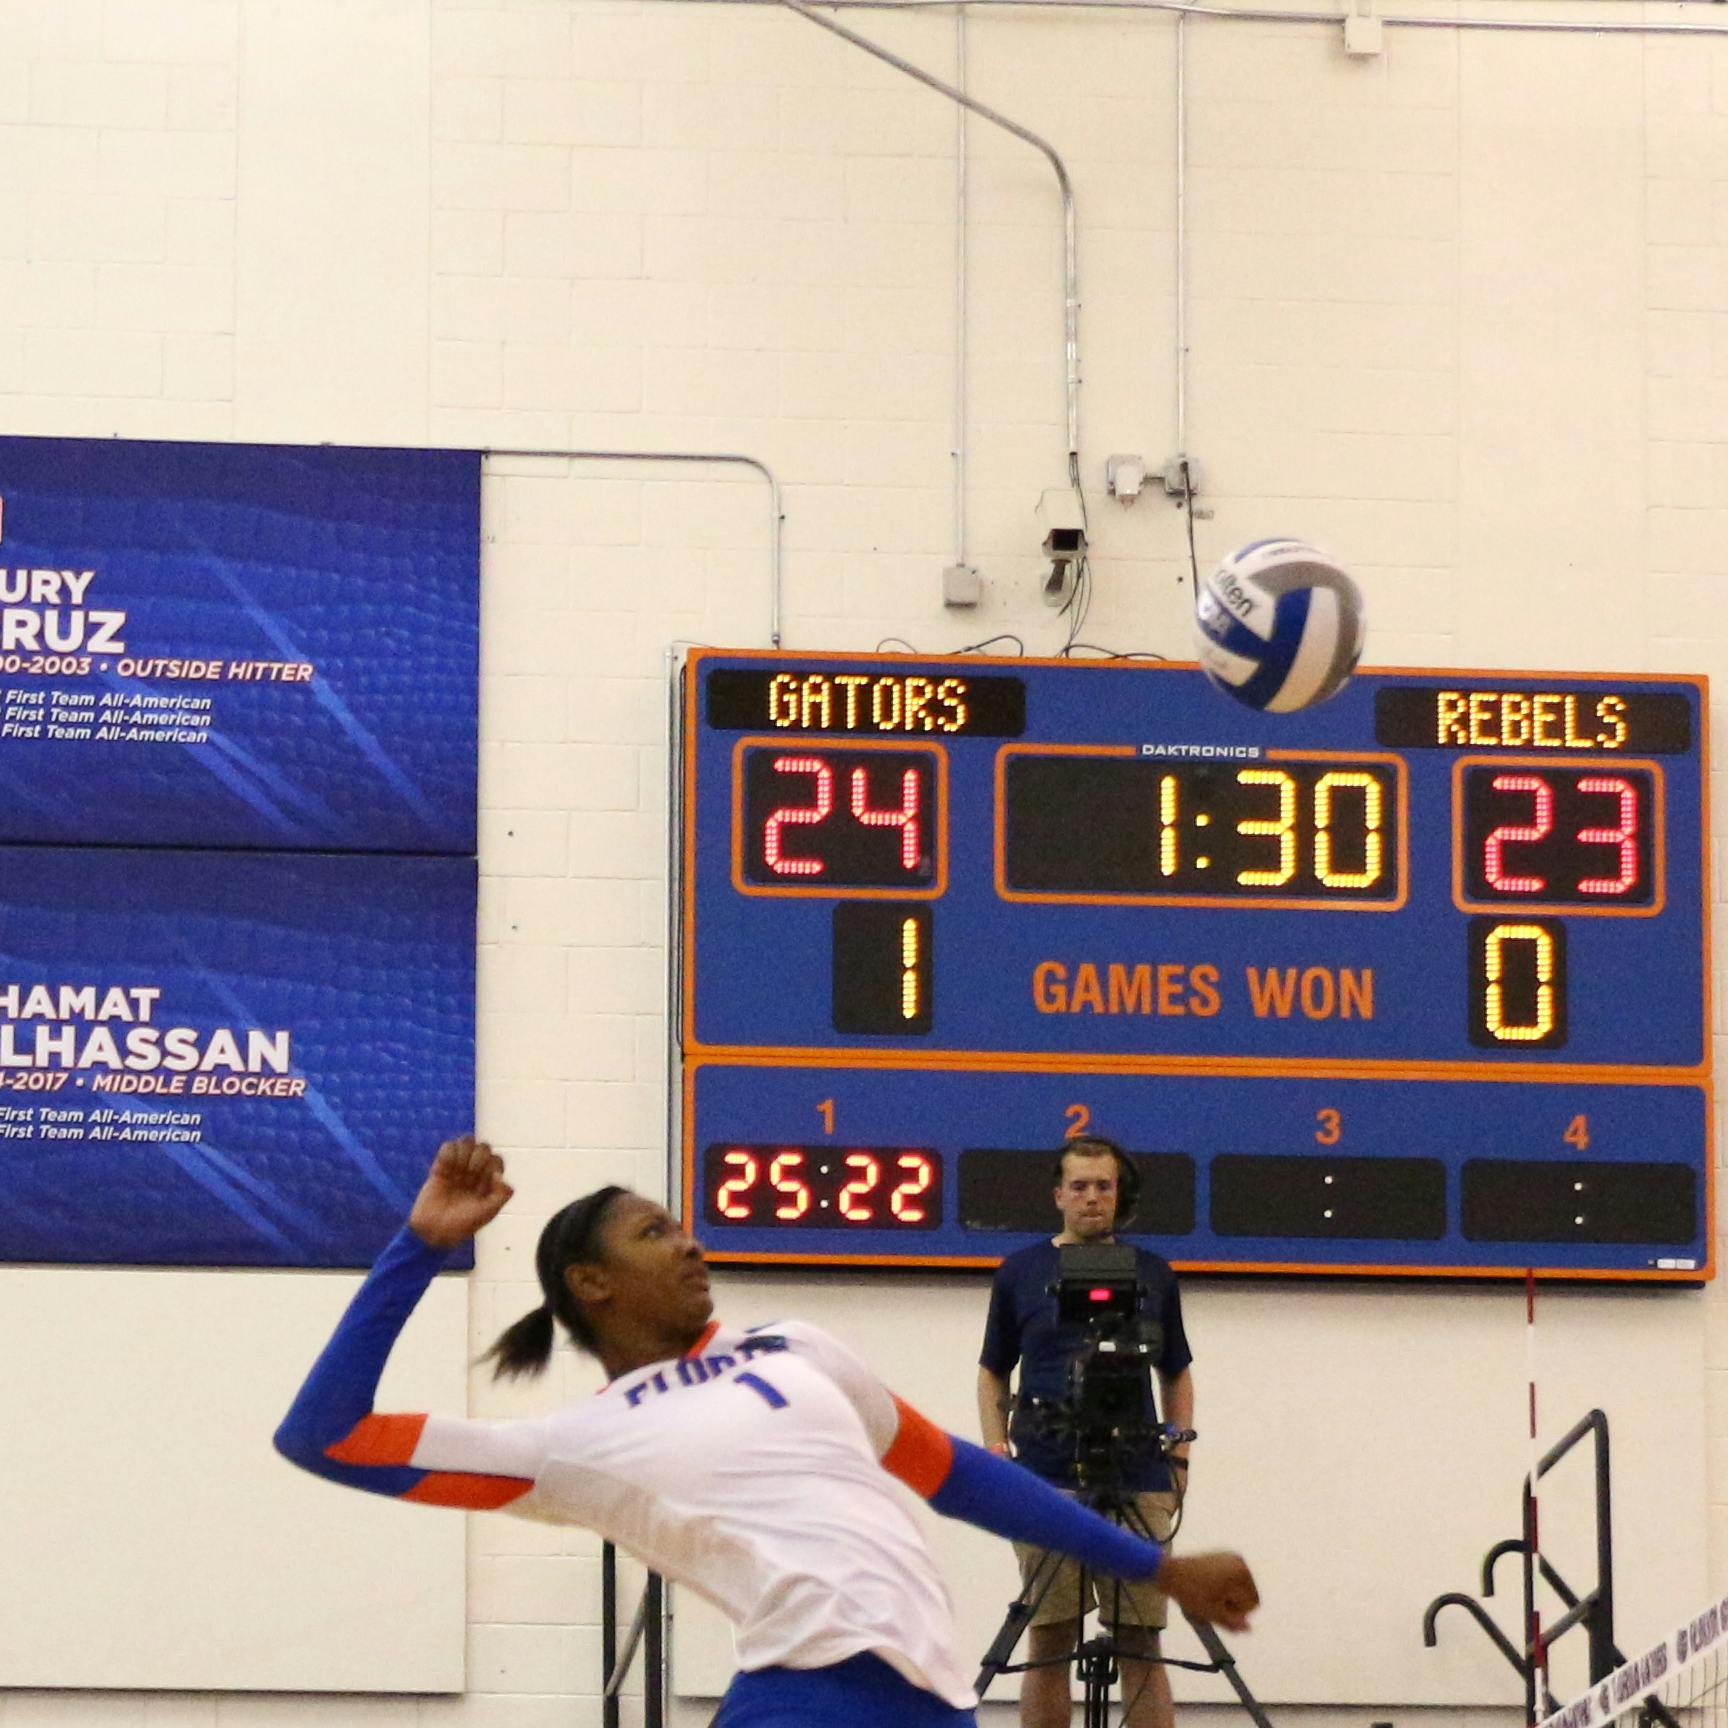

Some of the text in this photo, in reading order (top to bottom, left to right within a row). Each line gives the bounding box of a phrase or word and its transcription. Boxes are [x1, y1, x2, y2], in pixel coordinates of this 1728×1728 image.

[117, 658, 223, 680] OUTSIDE
[227, 661, 313, 682] HITTER
[5, 707, 44, 721] First
[50, 708, 94, 723] Team
[99, 710, 210, 726] All-American
[6, 690, 45, 704] First
[51, 691, 95, 706] Team
[99, 693, 211, 710] All-American
[769, 673, 967, 732] GATORS
[2, 724, 41, 738] First
[47, 725, 91, 739] Team
[96, 726, 208, 743] All-American
[1435, 695, 1629, 750] REBELS
[1142, 743, 1260, 758] DAKTRONICS
[764, 757, 920, 875] 24
[1155, 767, 1384, 890] 1:30
[1481, 775, 1641, 896] 23
[899, 916, 920, 1022] 1
[1481, 922, 1557, 1044] 0
[1032, 960, 1377, 1021] GAMES WON
[92, 1075, 184, 1094] MIDDLE
[191, 1077, 306, 1097] BLOCKER
[40, 1109, 83, 1122] Team
[88, 1109, 201, 1125] All-American
[40, 1126, 83, 1139] Team
[88, 1127, 200, 1142] All-American
[815, 1098, 835, 1135] 1
[1063, 1104, 1092, 1138] 2
[1314, 1107, 1345, 1146] 3
[1562, 1113, 1591, 1151] 4
[717, 1151, 931, 1223] 25:22
[733, 1371, 791, 1410] 1
